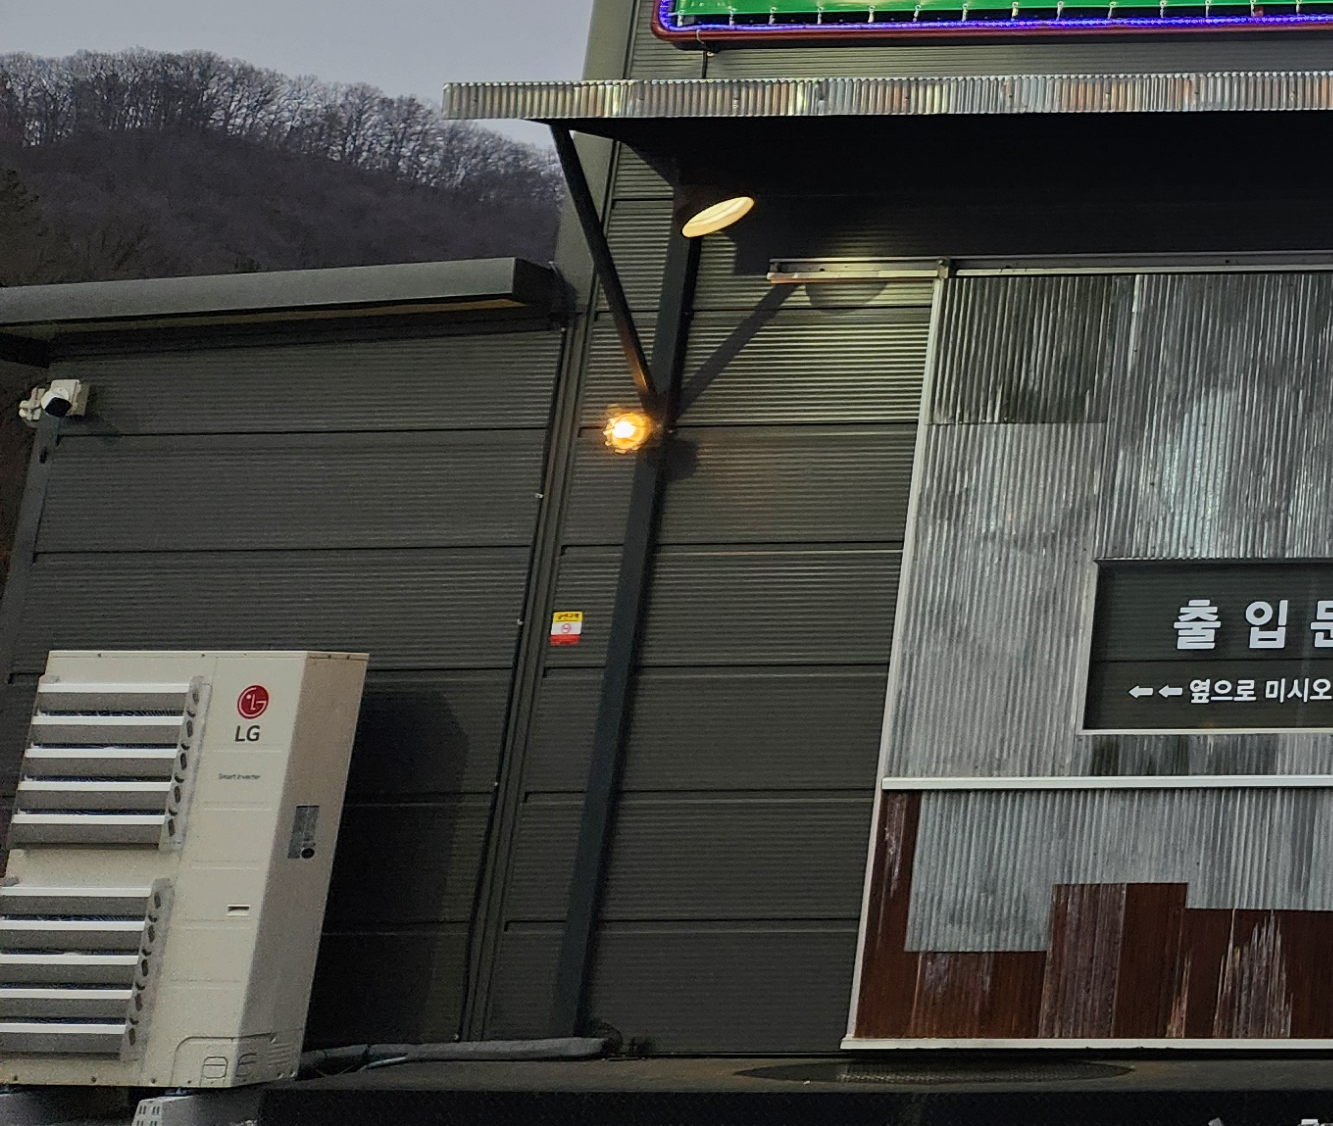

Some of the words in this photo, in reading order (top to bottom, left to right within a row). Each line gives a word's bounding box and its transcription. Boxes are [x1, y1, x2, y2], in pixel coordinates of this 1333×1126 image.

[1189, 678, 1257, 704] 옆으로
[1265, 677, 1333, 702] 미시오
[234, 725, 261, 742] LG
